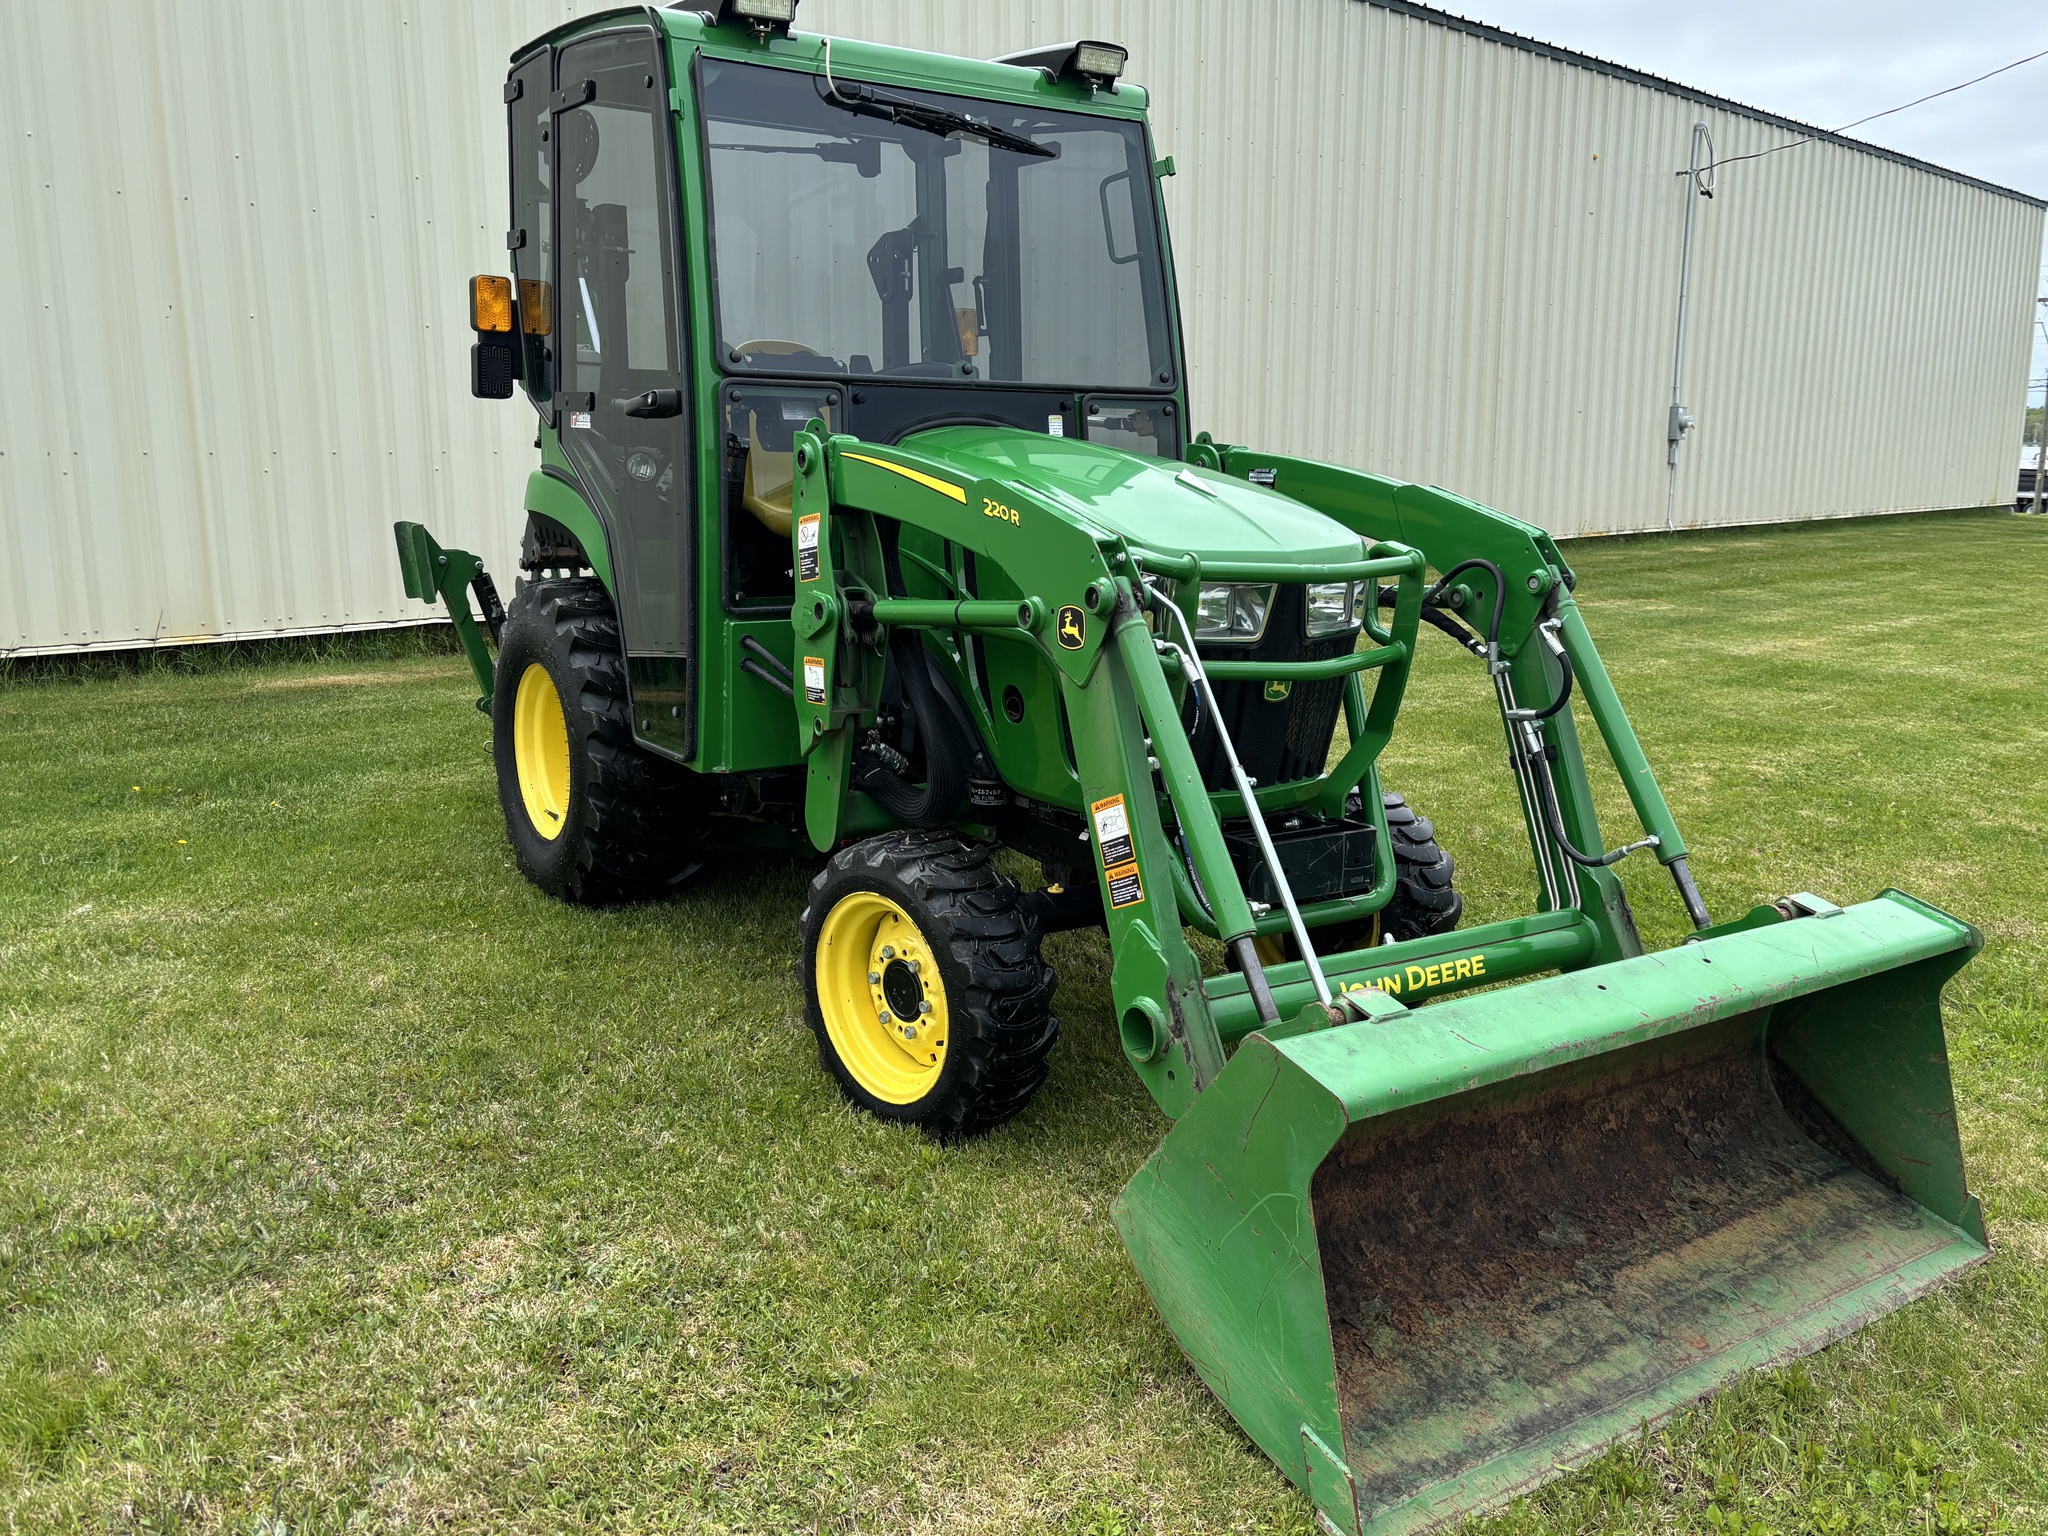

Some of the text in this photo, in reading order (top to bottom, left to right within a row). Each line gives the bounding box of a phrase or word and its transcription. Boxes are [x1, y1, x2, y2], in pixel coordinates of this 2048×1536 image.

[1099, 797, 1120, 809] WARNING
[1113, 866, 1136, 878] WARNING
[1405, 954, 1486, 991] DEERE
